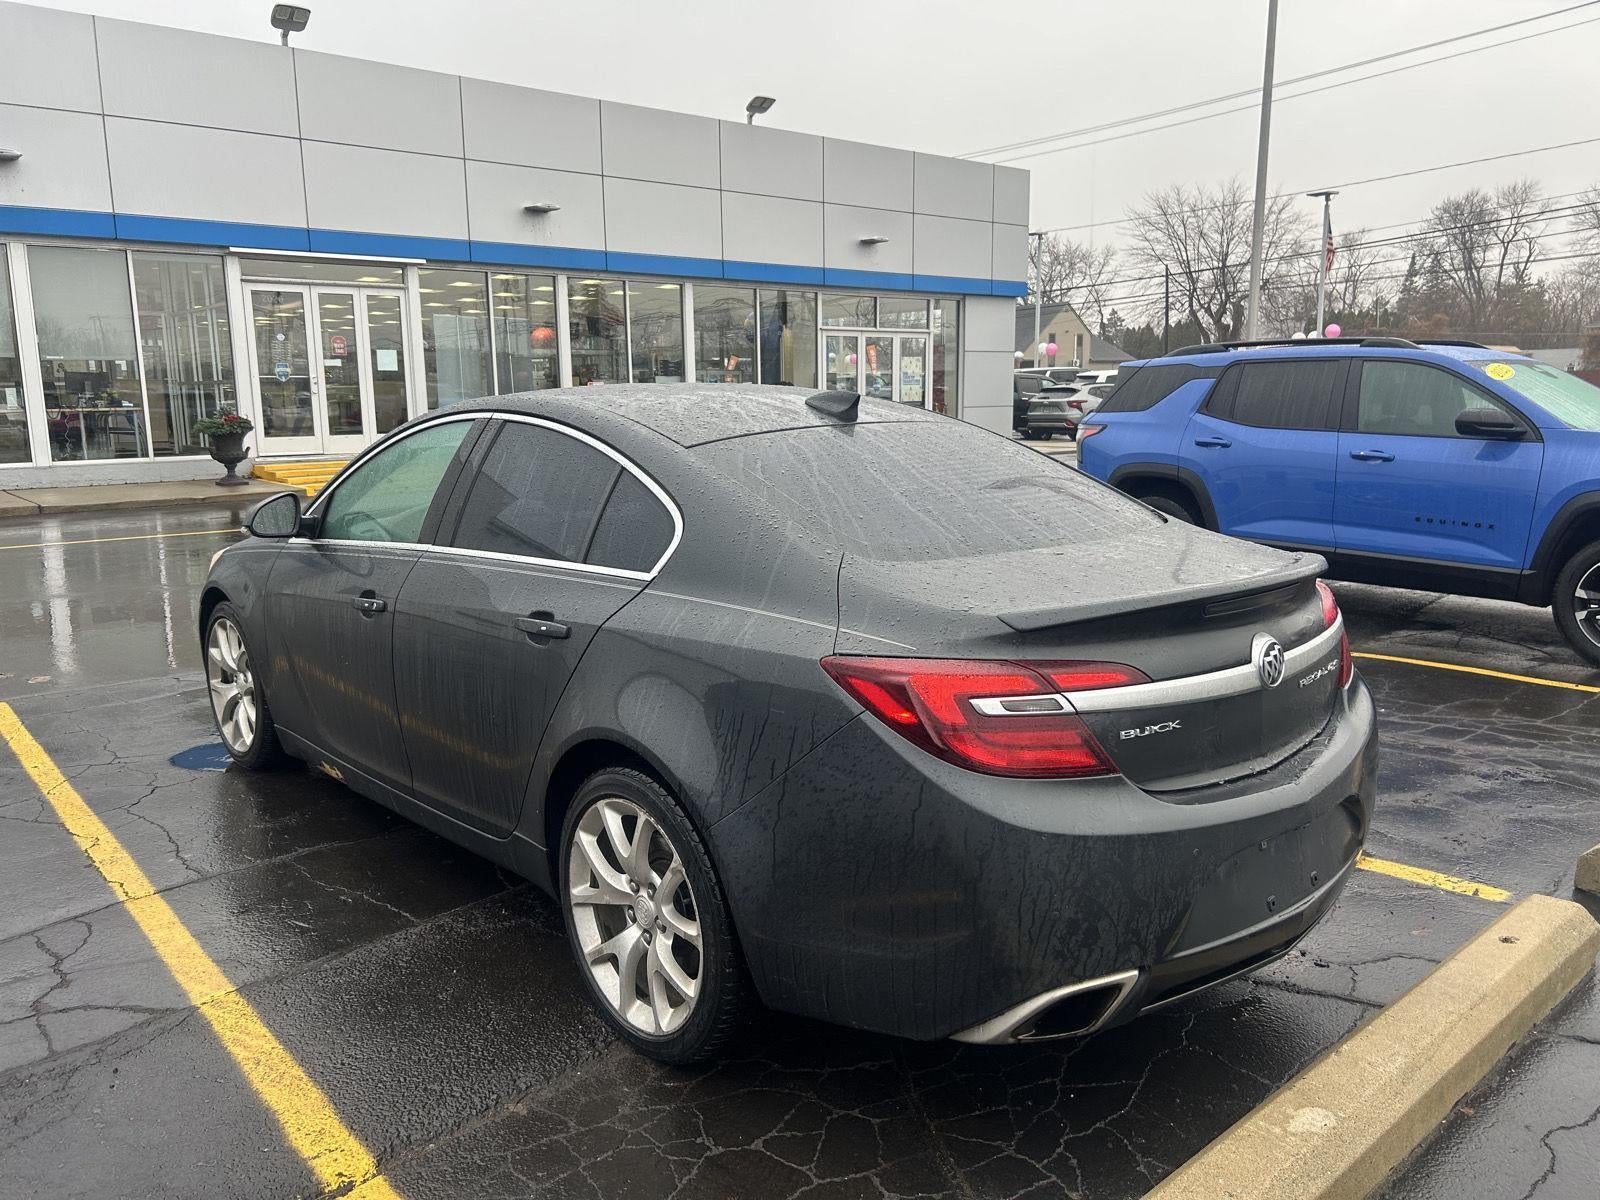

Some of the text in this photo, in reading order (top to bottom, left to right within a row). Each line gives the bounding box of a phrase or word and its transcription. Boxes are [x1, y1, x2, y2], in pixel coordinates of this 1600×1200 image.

[1414, 516, 1496, 530] EQUINOX
[1299, 667, 1329, 688] REGAL
[1119, 719, 1182, 740] BUICK
